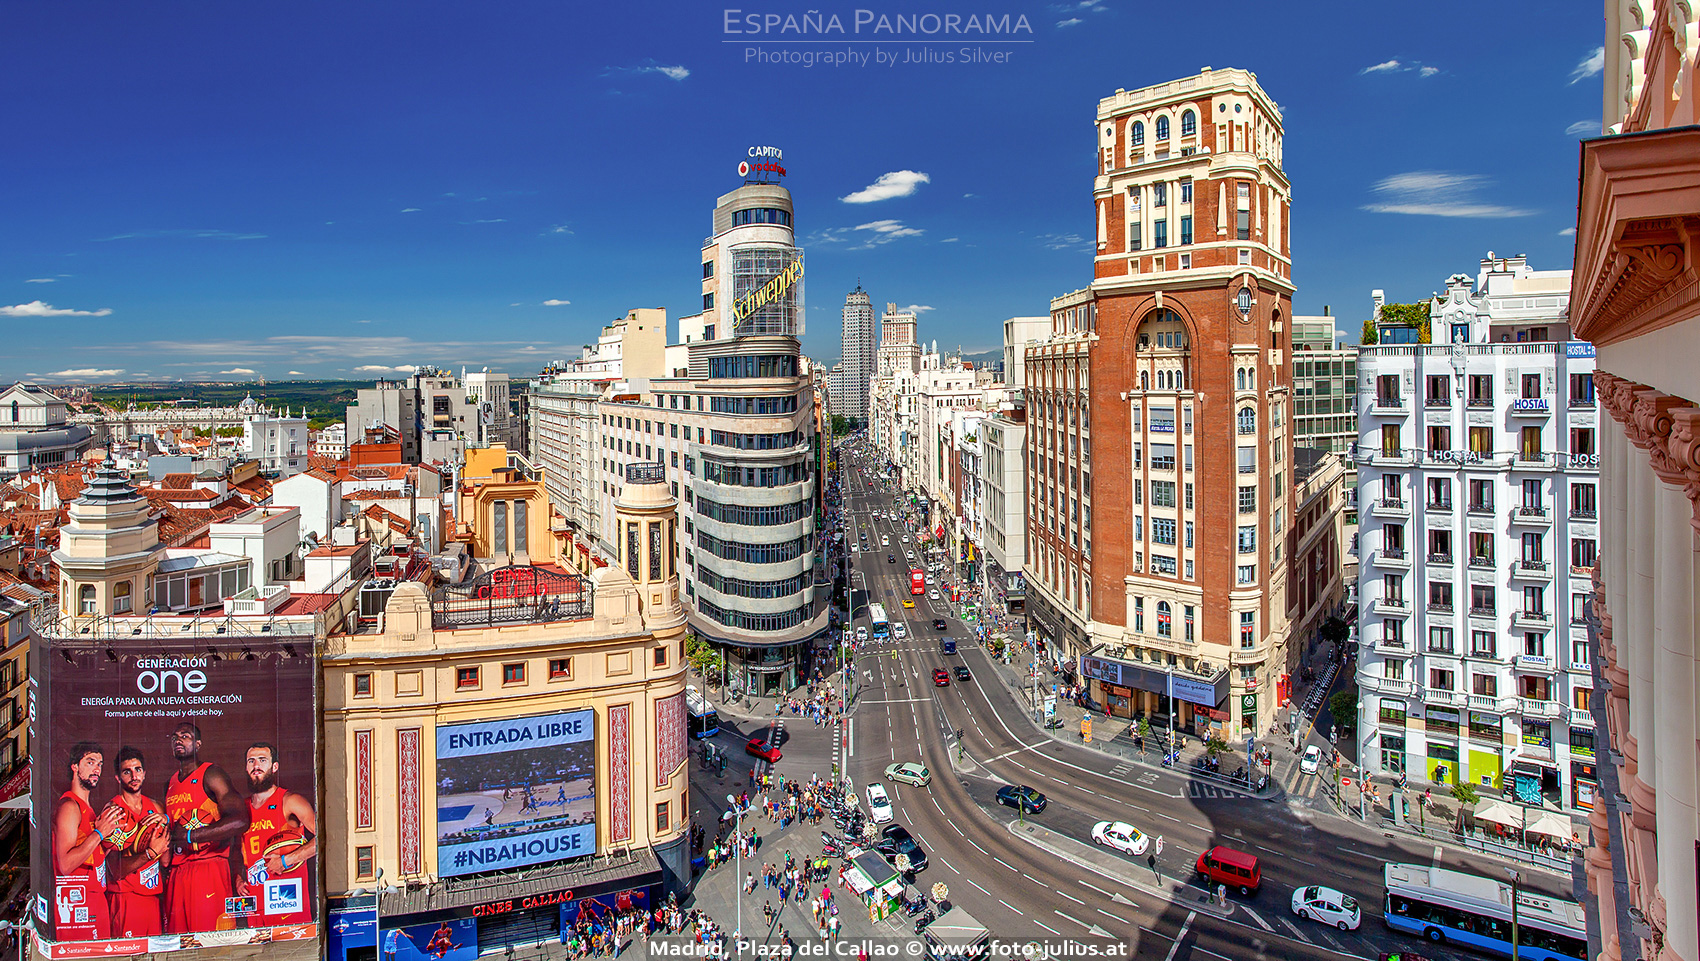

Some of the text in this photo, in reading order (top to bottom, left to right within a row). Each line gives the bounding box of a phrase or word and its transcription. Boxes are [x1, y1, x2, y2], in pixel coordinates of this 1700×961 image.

[732, 254, 804, 329] Schweppes
[1567, 345, 1587, 356] HOSTAL
[1514, 398, 1549, 409] HOSTAL
[1433, 449, 1600, 465] HOSTAL JOS
[492, 567, 534, 583] CINES
[477, 582, 548, 600] CALLAO
[136, 655, 207, 668] GENERACIÓN
[1522, 655, 1545, 663] HOSTAL
[136, 669, 207, 694] one
[81, 693, 242, 706] ENERGÍA PARA UNA NUEVA GENERACIÓN
[104, 709, 125, 717] Forma
[126, 710, 143, 719] parte
[144, 709, 153, 717] de
[153, 709, 166, 717] ella
[166, 708, 181, 718] aquí
[187, 708, 208, 716] desde
[209, 708, 224, 718] hoy.
[449, 719, 582, 749] ENTRADA LIBRE
[166, 791, 193, 807] ESPAÑA
[249, 835, 260, 855] 6
[454, 833, 581, 867] #NBAHOUSE
[269, 900, 297, 909] endesa
[472, 900, 513, 917] CINES
[522, 890, 574, 909] CALLAO
[67, 946, 92, 954] Santander
[113, 943, 141, 952] Santander
